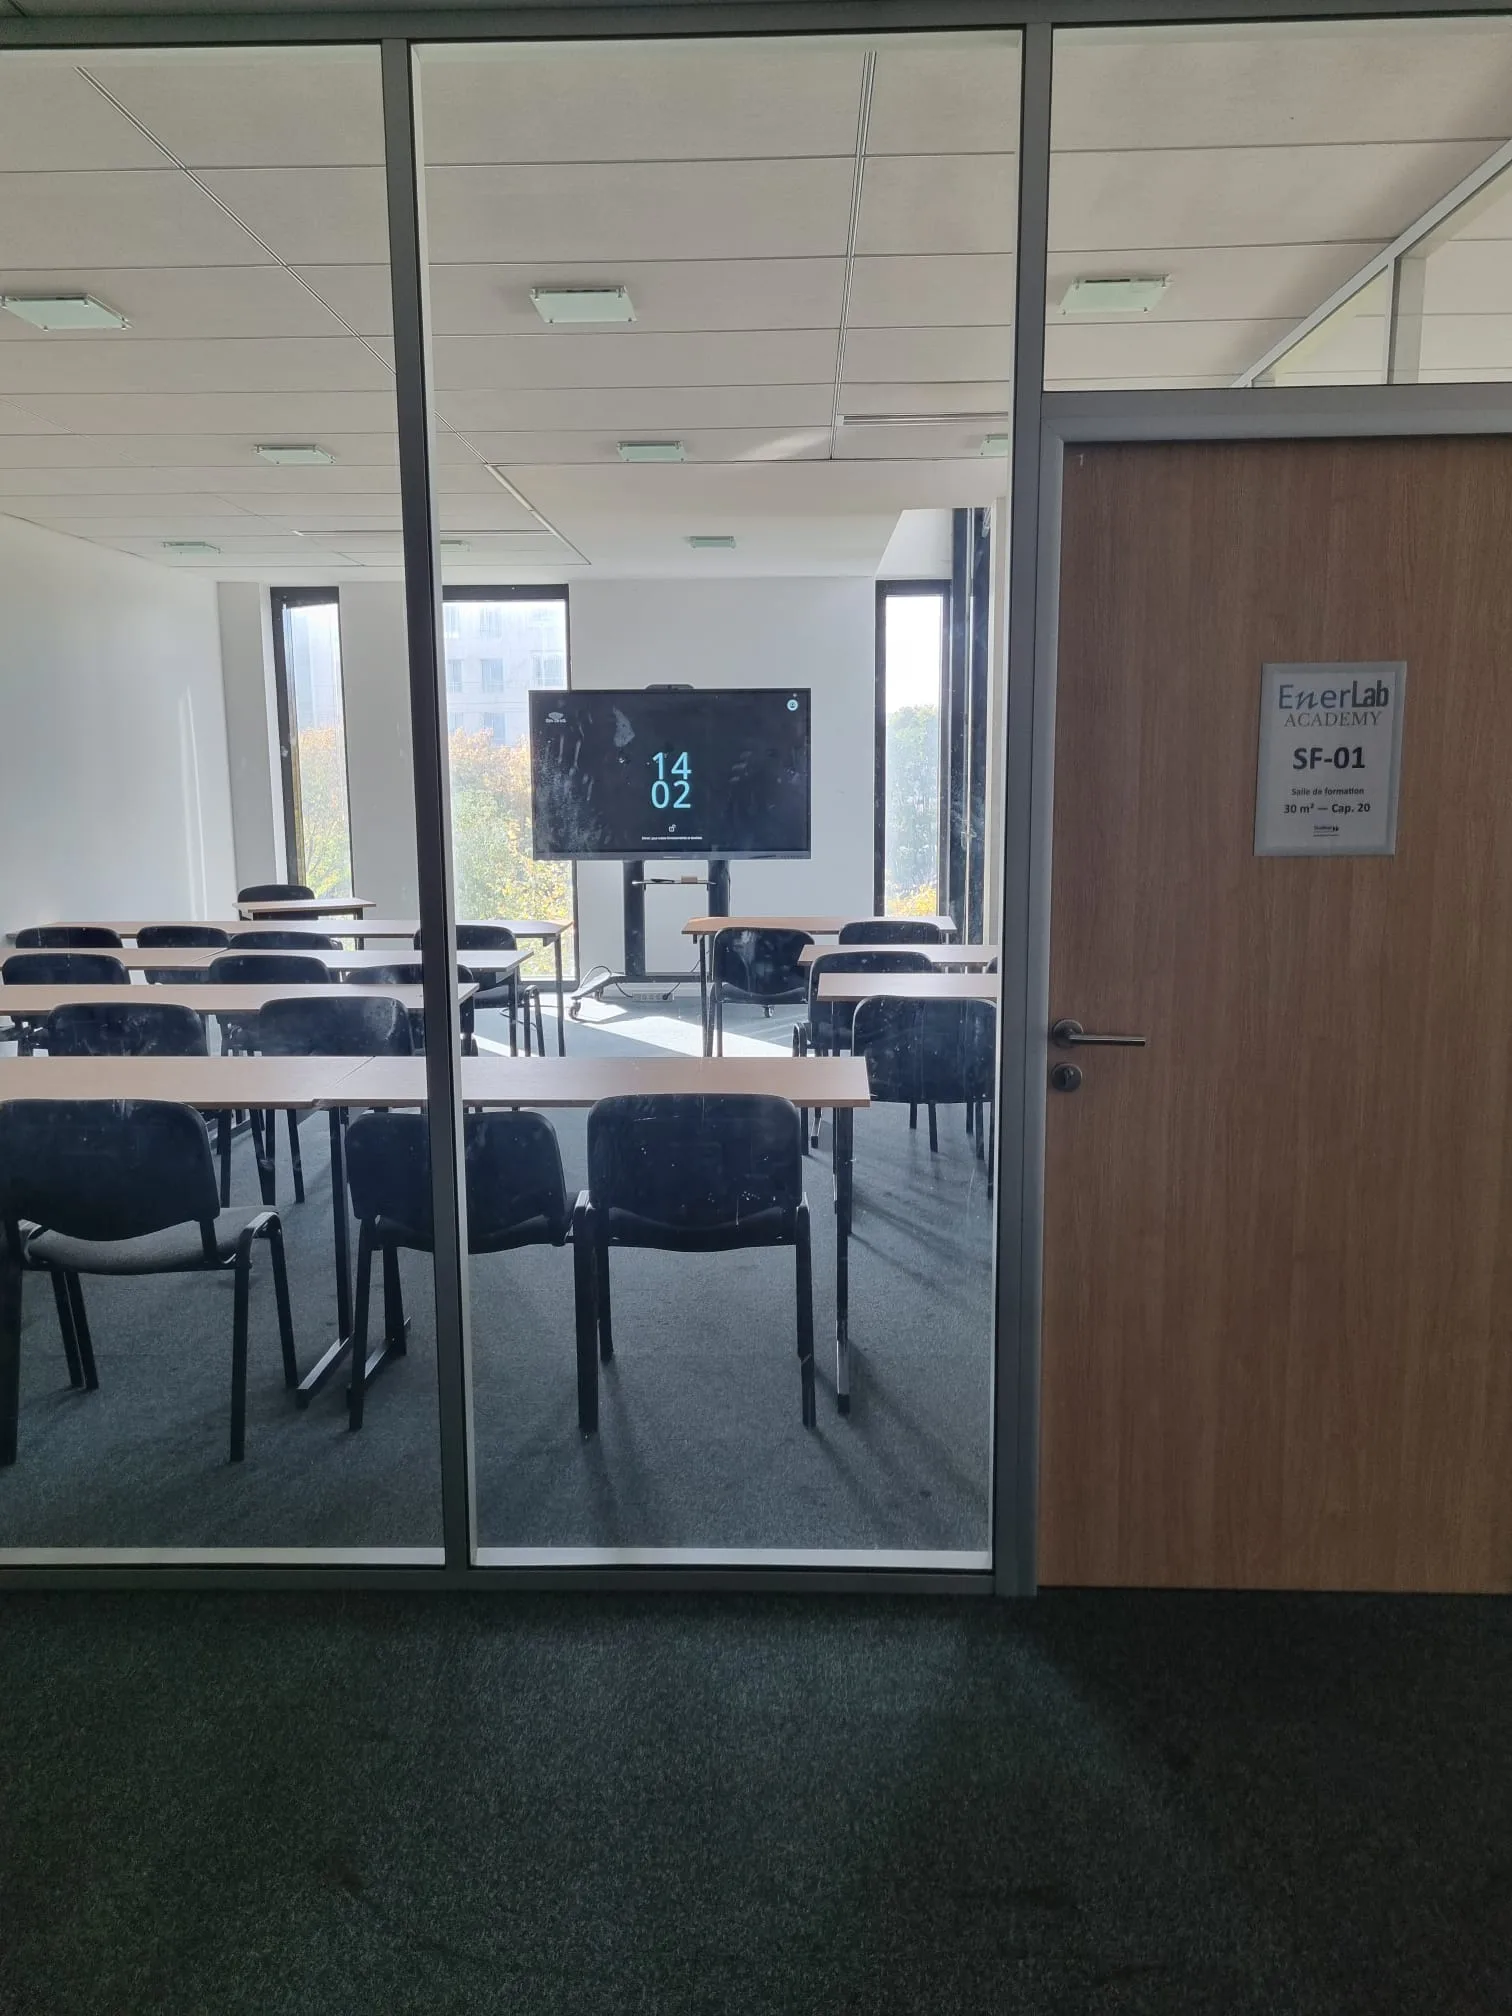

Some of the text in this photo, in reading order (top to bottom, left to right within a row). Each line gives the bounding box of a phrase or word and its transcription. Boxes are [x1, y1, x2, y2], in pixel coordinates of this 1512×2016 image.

[1279, 680, 1389, 710] EnerLab
[1284, 711, 1382, 727] ACADEMY
[652, 752, 692, 780] 14
[1293, 747, 1365, 770] SF-01
[651, 780, 691, 809] 02
[1291, 787, 1364, 796] Salle de formation
[1284, 804, 1297, 814] 30
[1300, 803, 1314, 814] m²
[1332, 803, 1354, 815] Cap.
[1357, 803, 1371, 813] 20
